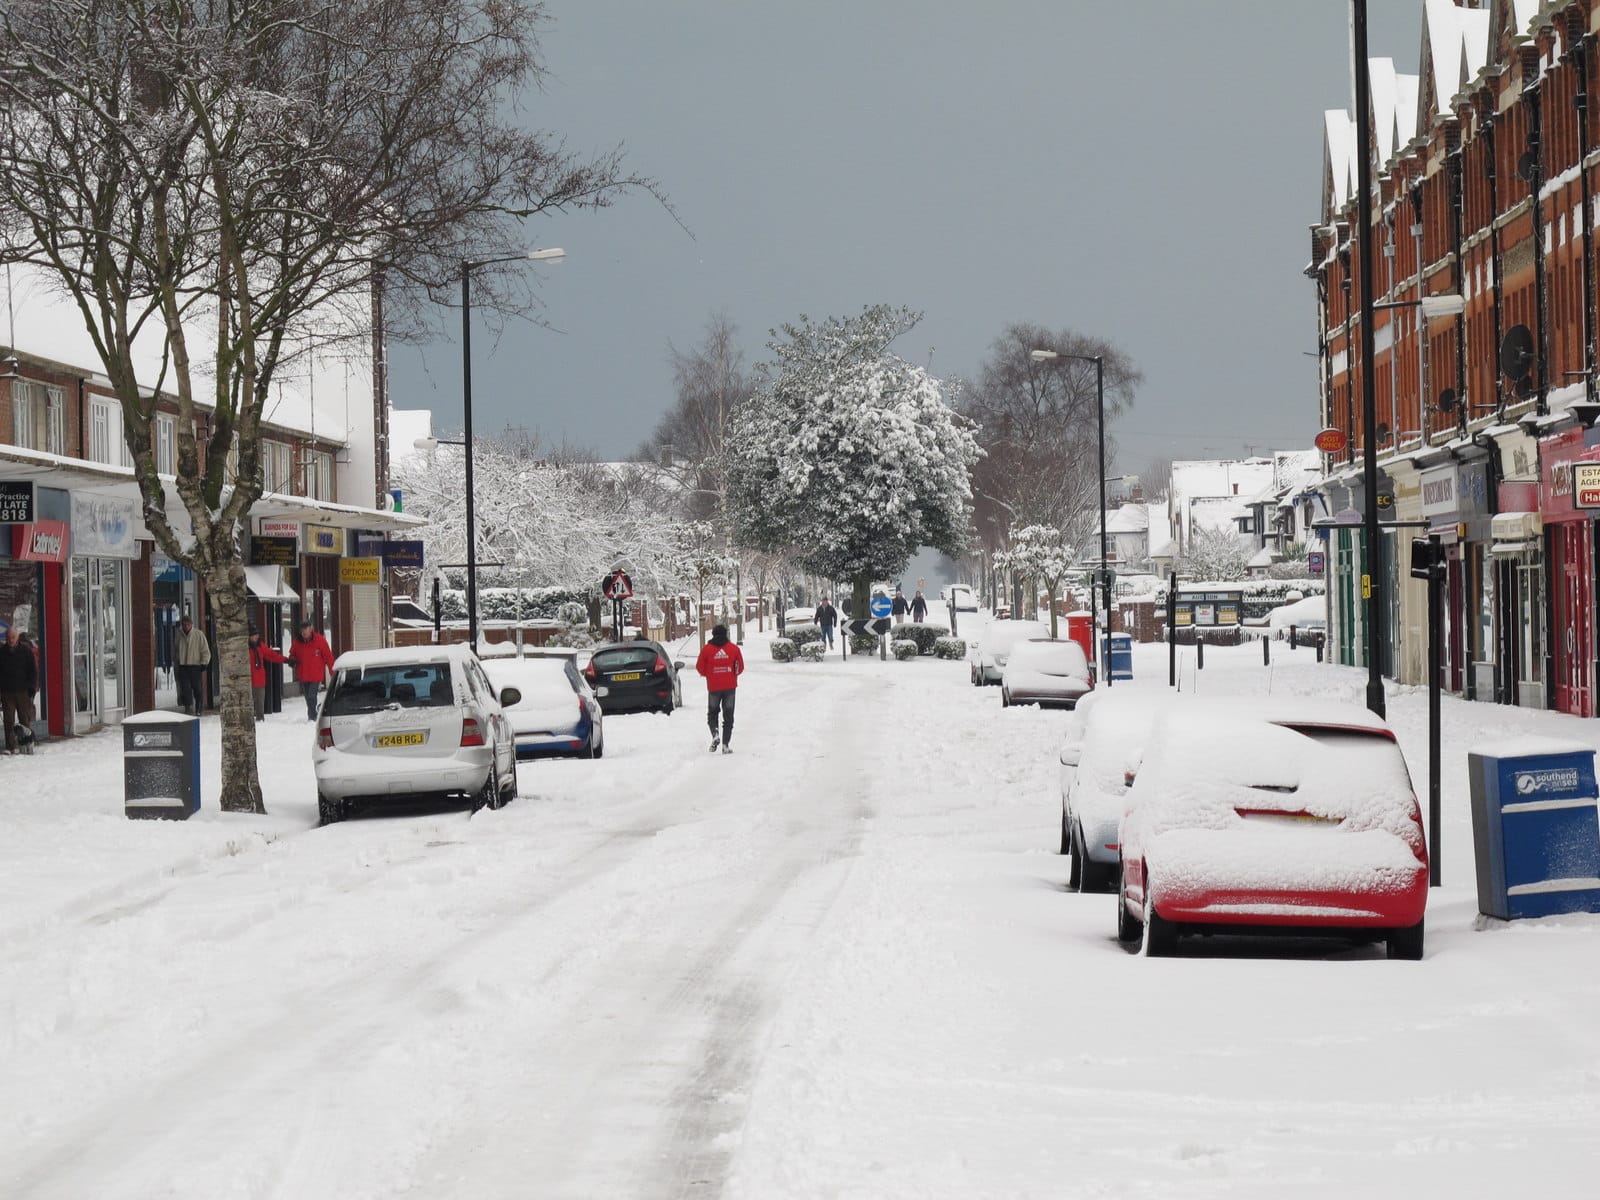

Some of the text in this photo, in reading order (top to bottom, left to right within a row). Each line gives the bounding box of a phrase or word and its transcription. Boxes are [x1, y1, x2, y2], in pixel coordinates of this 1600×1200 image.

[4, 501, 28, 509] LATE
[2, 510, 26, 520] 818
[341, 568, 378, 576] OPTICIANS
[1536, 771, 1577, 782] southend
